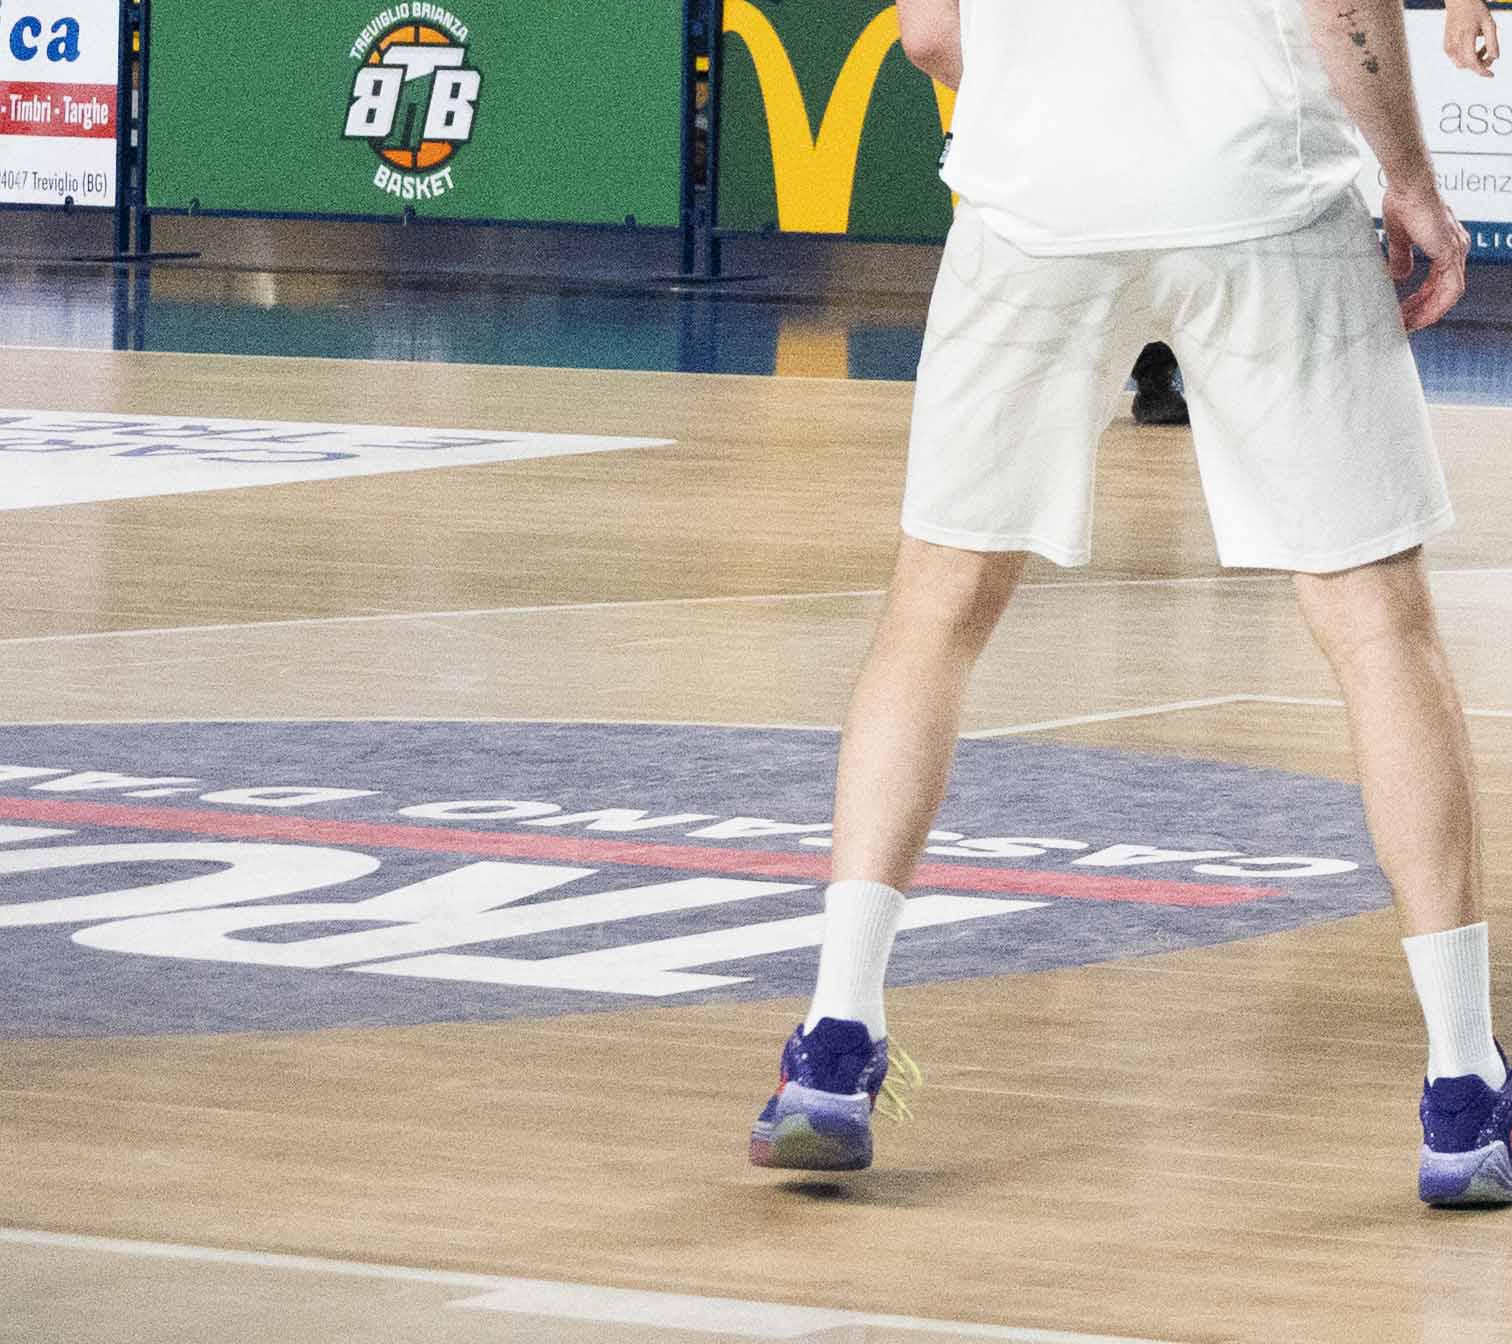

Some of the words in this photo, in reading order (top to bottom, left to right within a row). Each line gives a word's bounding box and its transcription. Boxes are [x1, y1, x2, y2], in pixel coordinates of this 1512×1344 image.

[9, 16, 81, 62] ca
[350, 1, 410, 62] TREVIGLIO
[411, 1, 470, 44] BRIANZA
[10, 93, 52, 123] Timbri
[63, 96, 108, 129] Targhe
[0, 170, 28, 190] 4047
[32, 171, 79, 196] Treviglio
[83, 174, 107, 198] (BG)
[372, 164, 458, 201] BASKET
